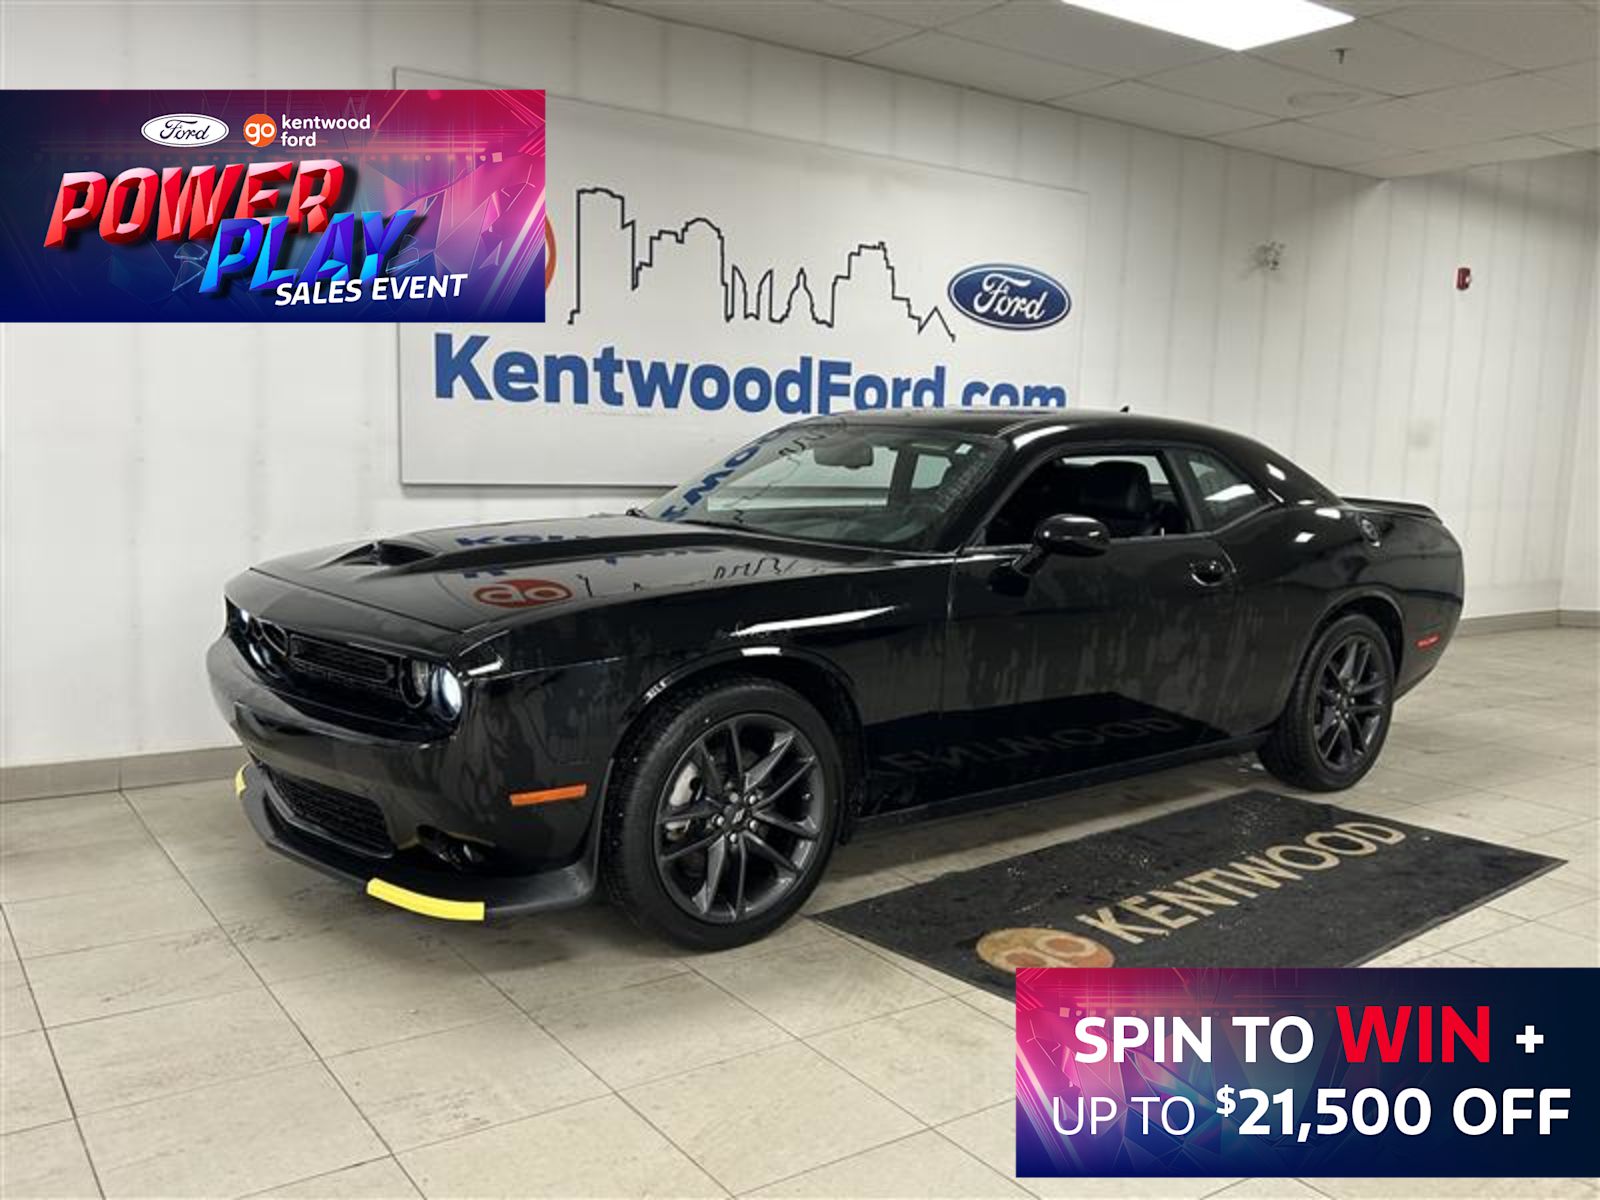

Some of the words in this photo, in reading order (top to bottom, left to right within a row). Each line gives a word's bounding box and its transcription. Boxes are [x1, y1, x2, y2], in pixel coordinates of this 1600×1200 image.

[973, 273, 1048, 320] Ford
[434, 333, 1066, 414] KentwoodFordcom
[1074, 821, 1406, 944] KENTWOOD
